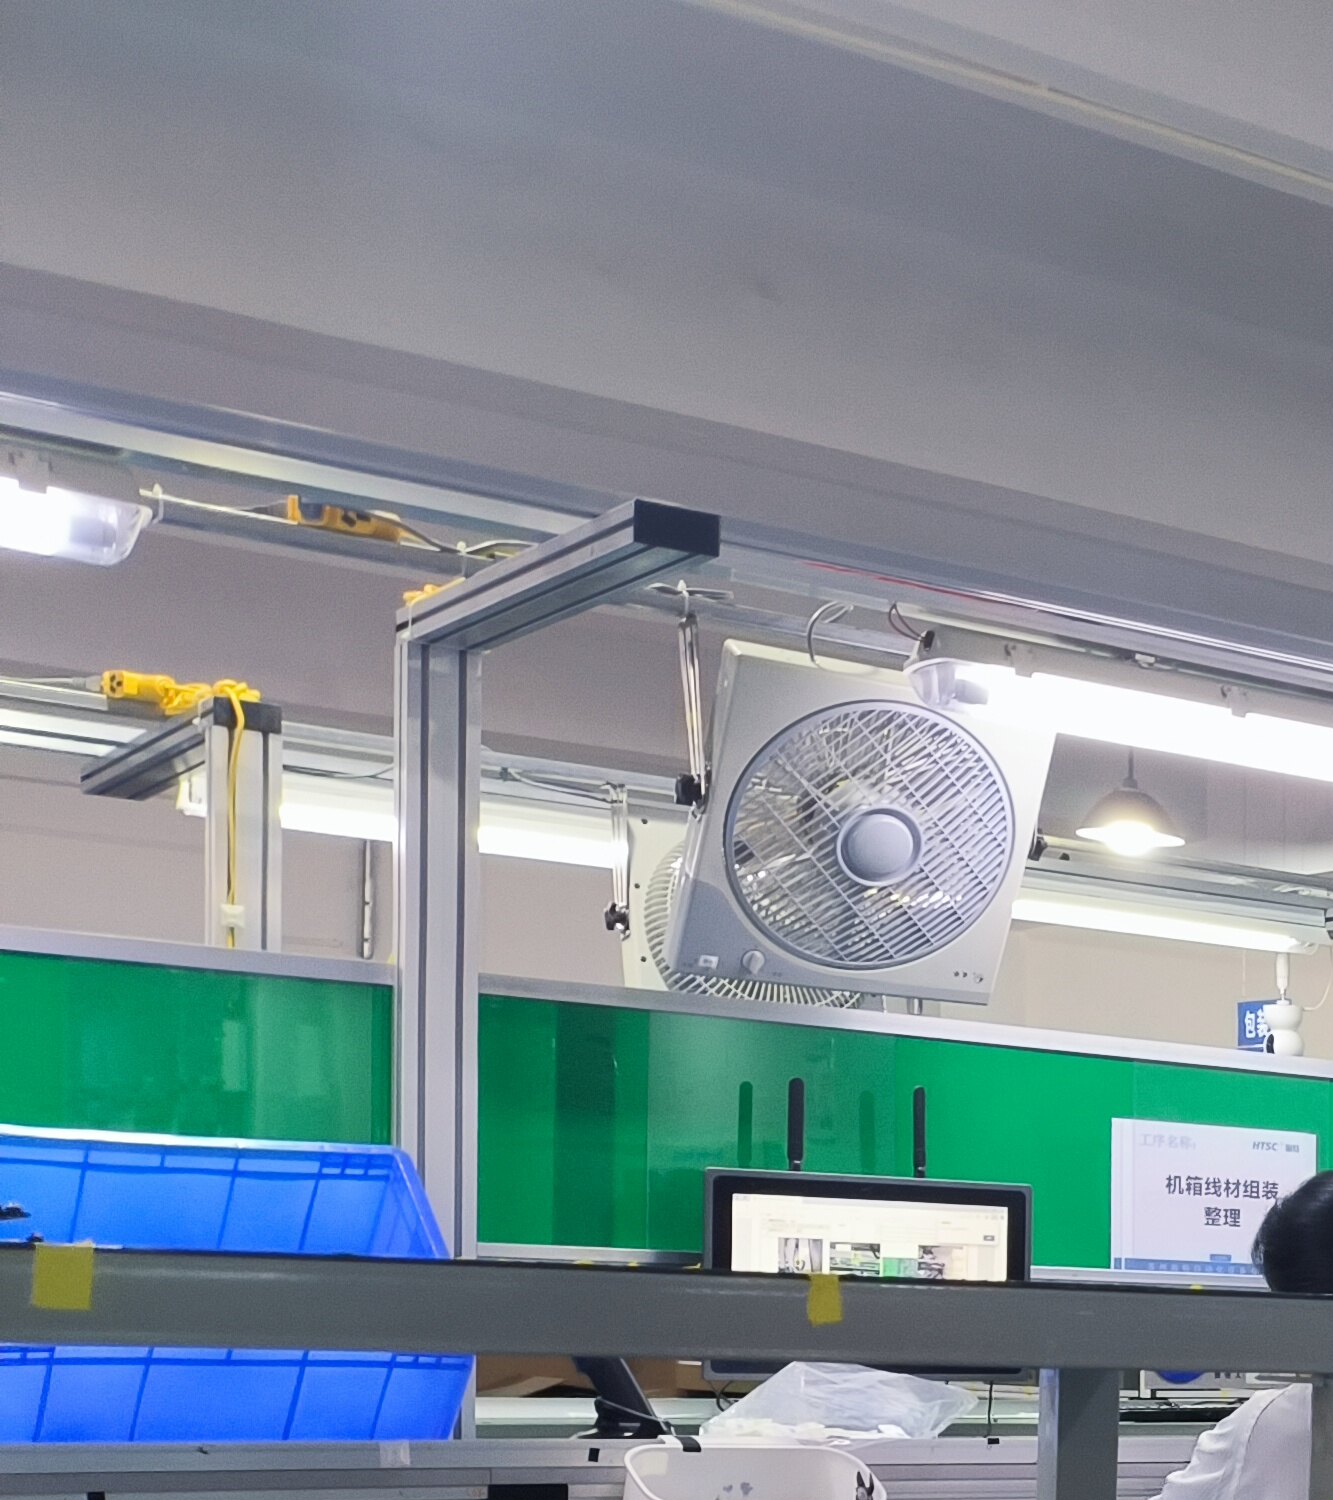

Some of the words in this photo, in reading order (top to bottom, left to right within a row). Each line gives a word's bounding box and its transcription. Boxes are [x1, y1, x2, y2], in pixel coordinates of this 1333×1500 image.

[1252, 1140, 1279, 1152] HTSC
[1165, 1174, 1280, 1200] 机箱线材组装
[1204, 1206, 1241, 1228] 整理
